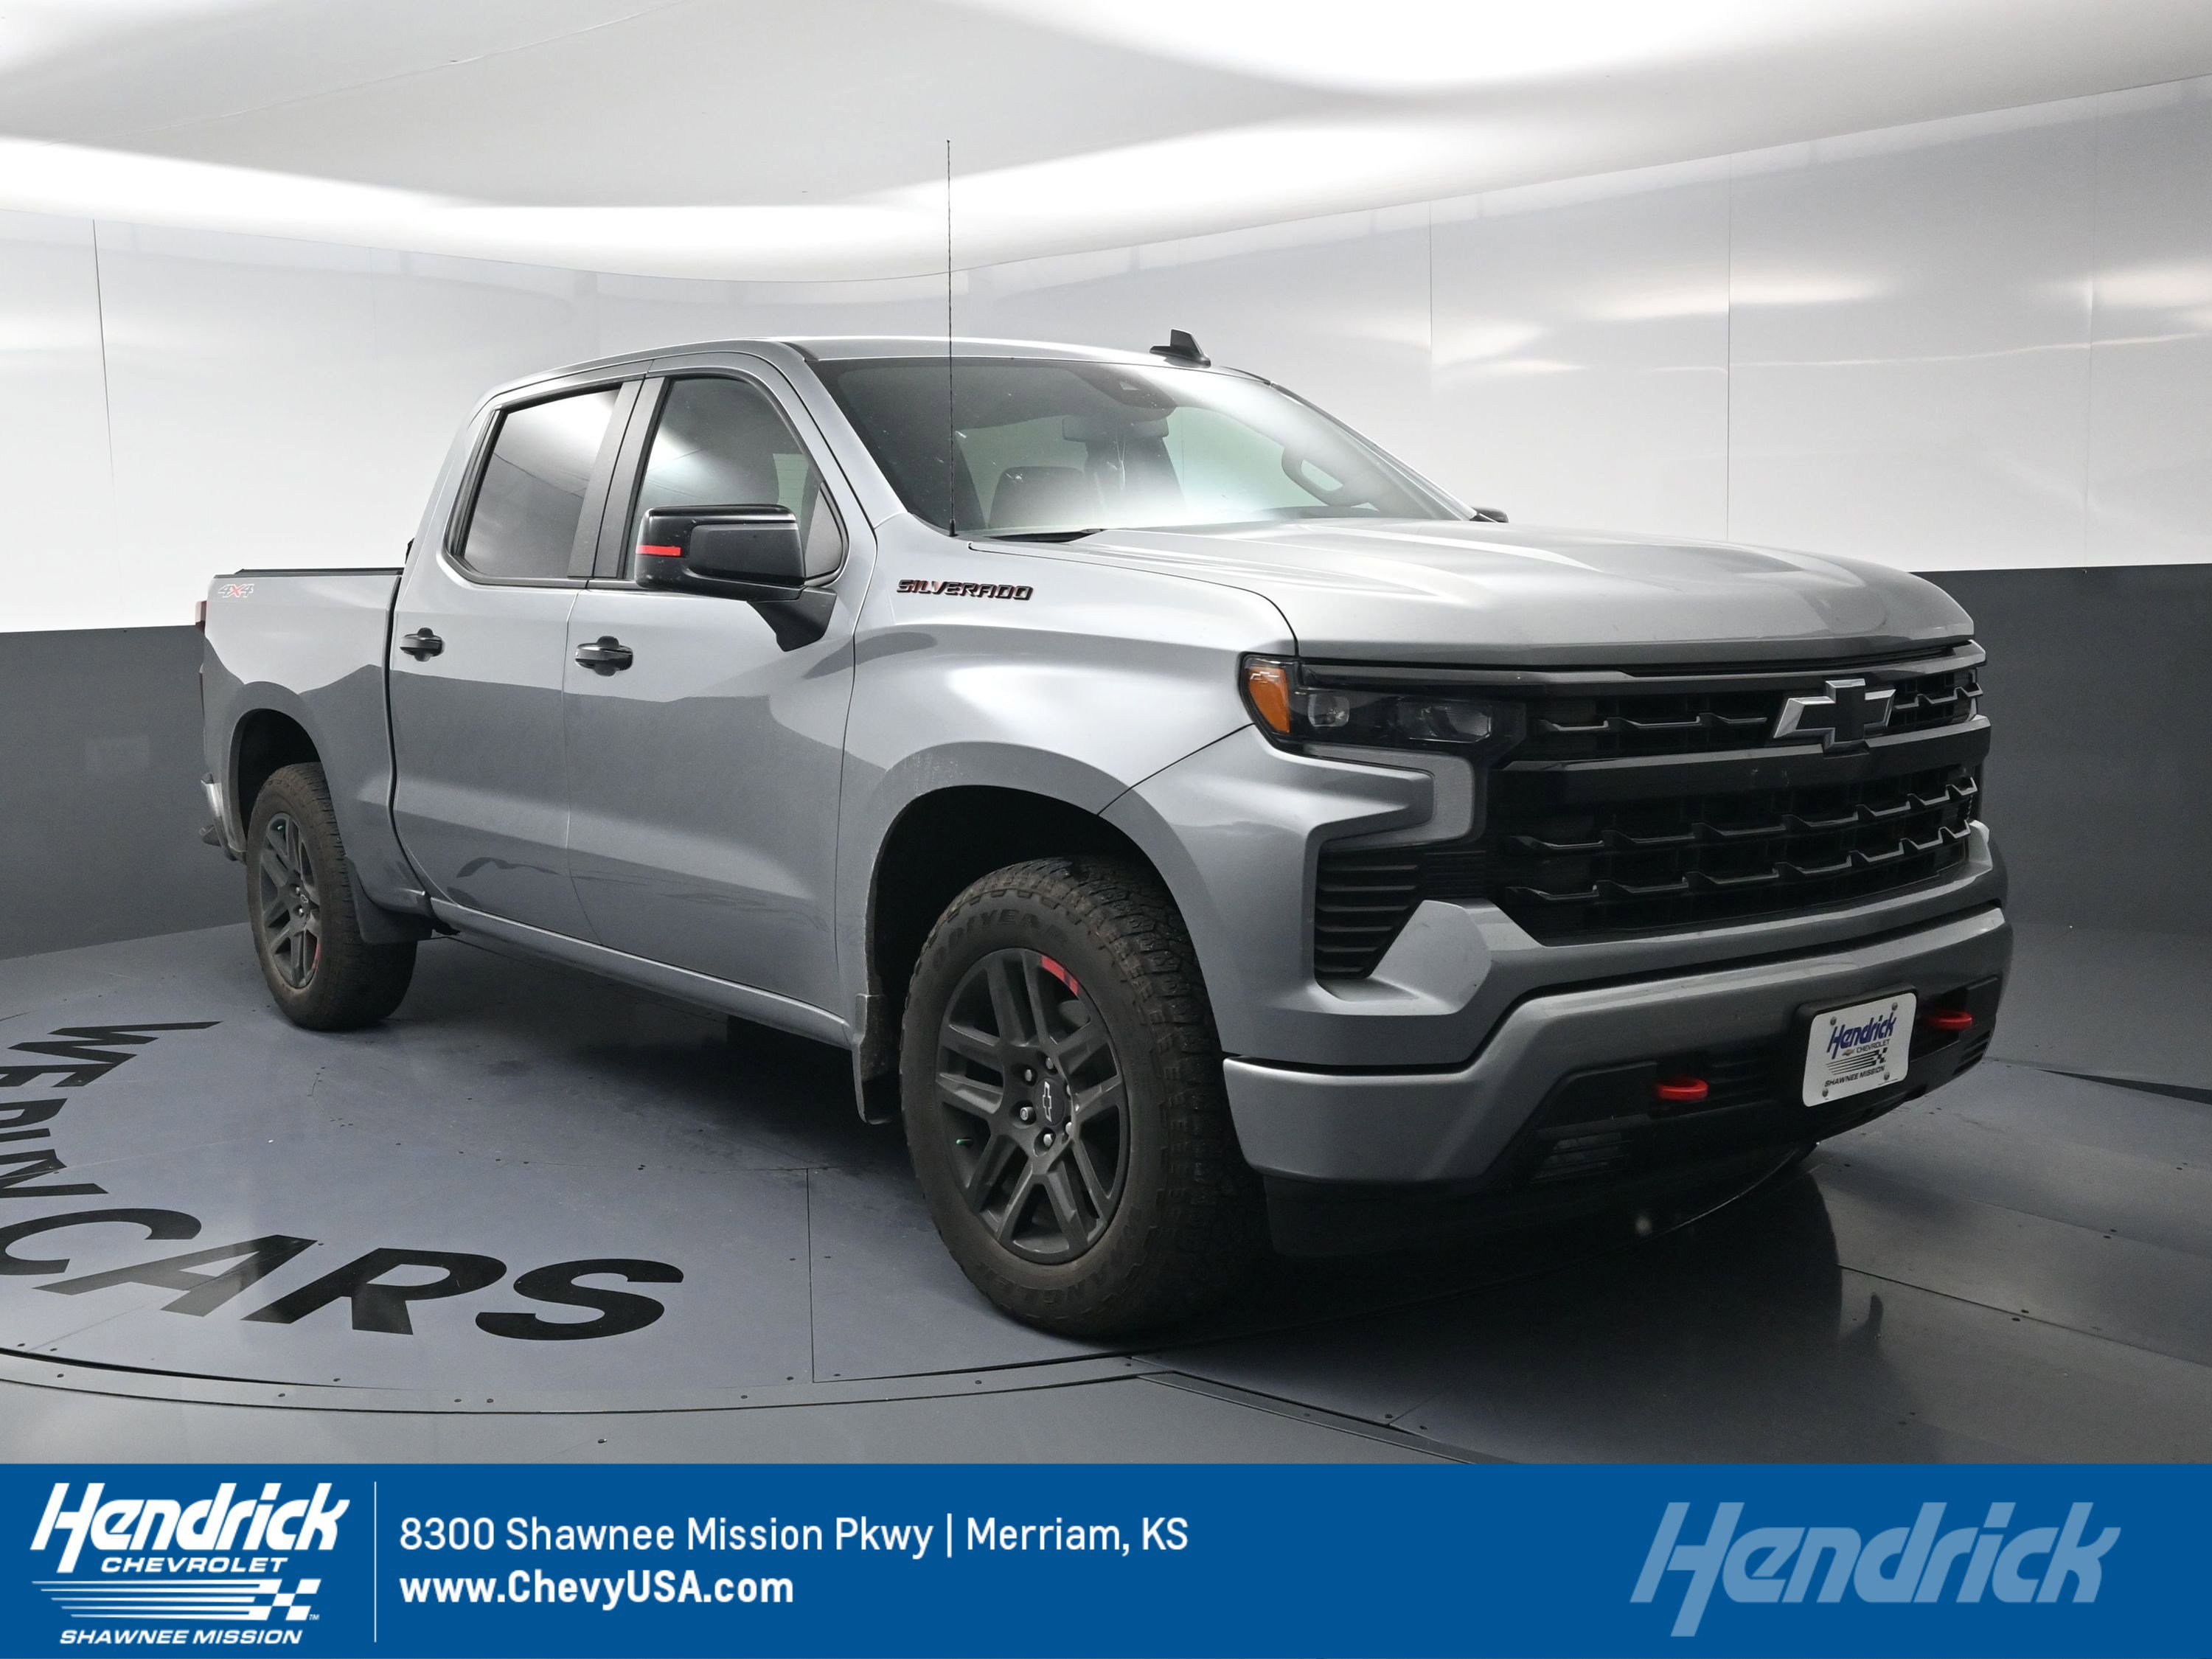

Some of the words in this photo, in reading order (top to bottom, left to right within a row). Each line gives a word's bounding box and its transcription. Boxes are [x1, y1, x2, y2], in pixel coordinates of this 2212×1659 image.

[897, 579, 1034, 601] SILVERADO
[1826, 1012, 1897, 1060] Hendrick
[1856, 1039, 1891, 1054] CHEVROLET
[1824, 1073, 1859, 1088] SHAWNEE
[1860, 1065, 1885, 1079] MISSION
[0, 1208, 684, 1341] CARS
